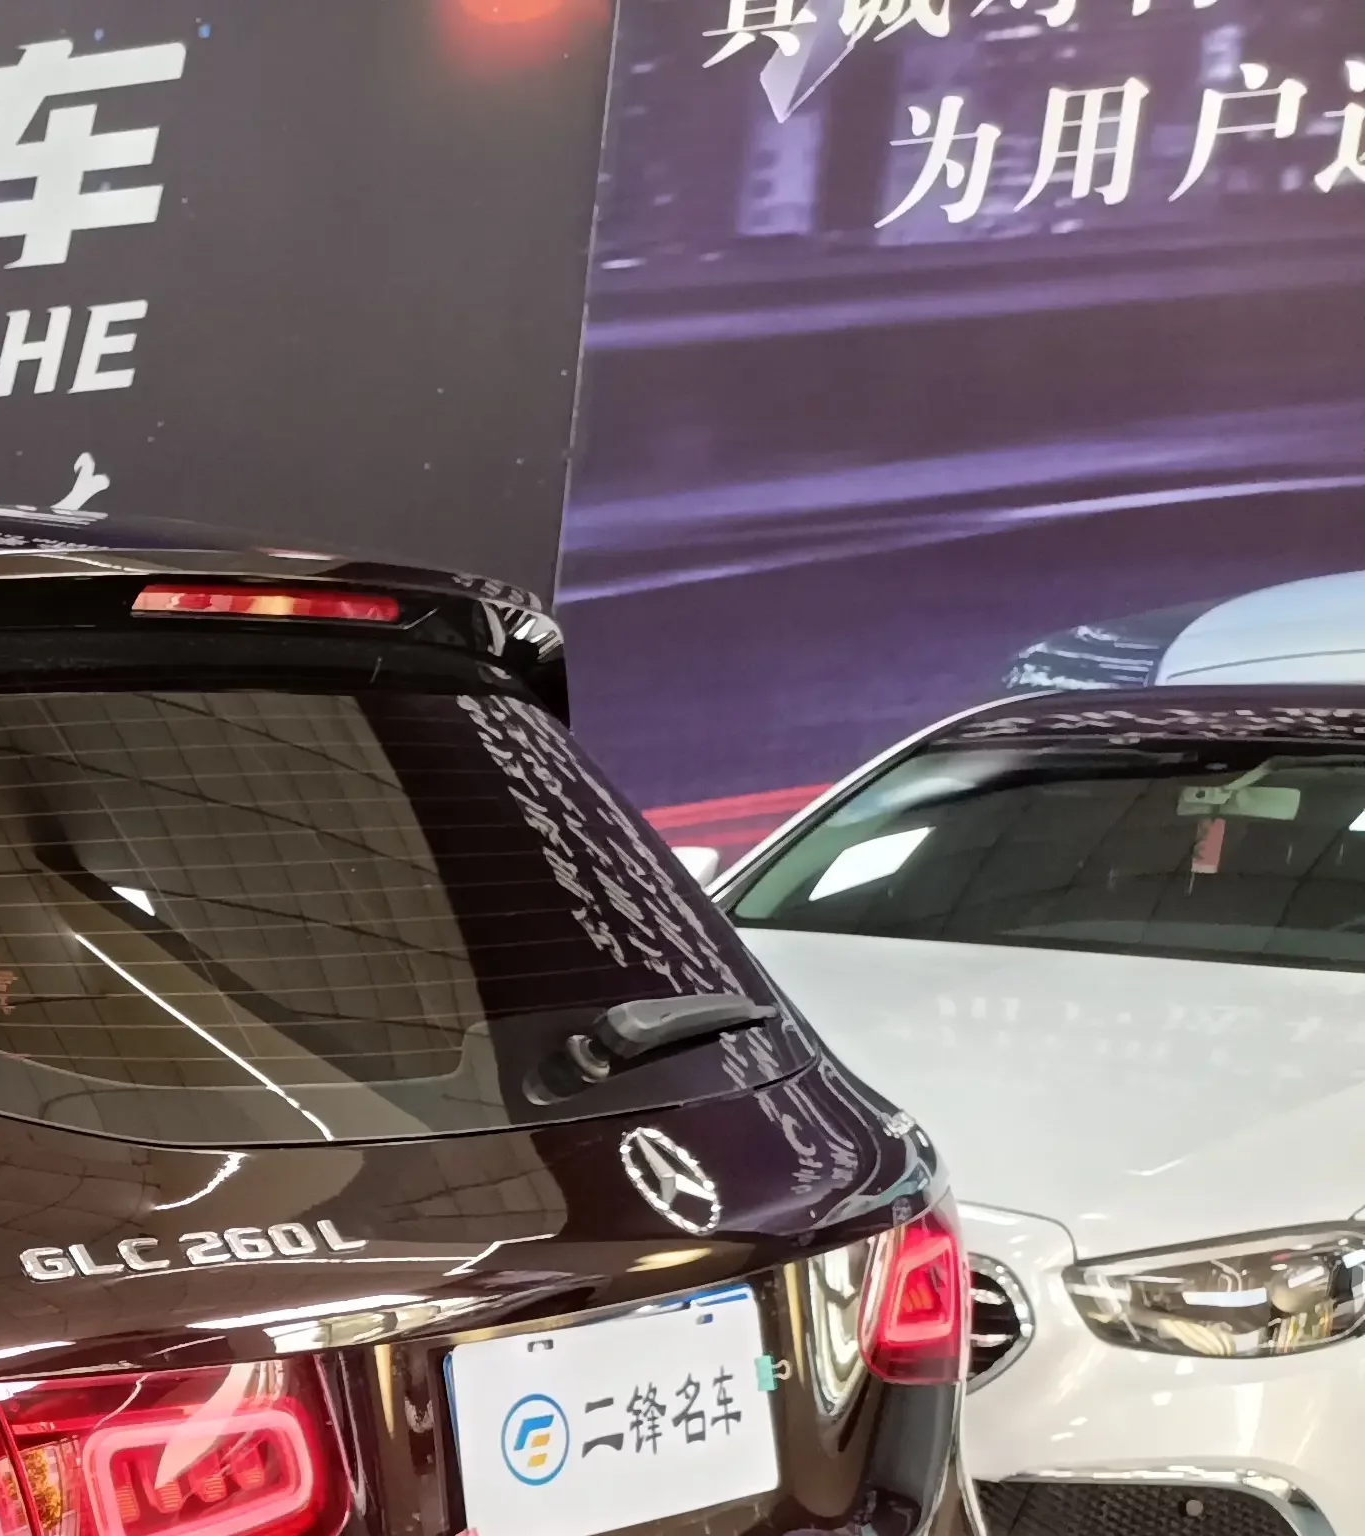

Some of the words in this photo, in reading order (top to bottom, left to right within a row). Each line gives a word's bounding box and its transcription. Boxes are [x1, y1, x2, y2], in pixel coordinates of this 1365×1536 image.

[20, 1236, 171, 1284] GLC
[178, 1218, 368, 1268] 260L
[580, 1364, 742, 1460] 二锋名车
